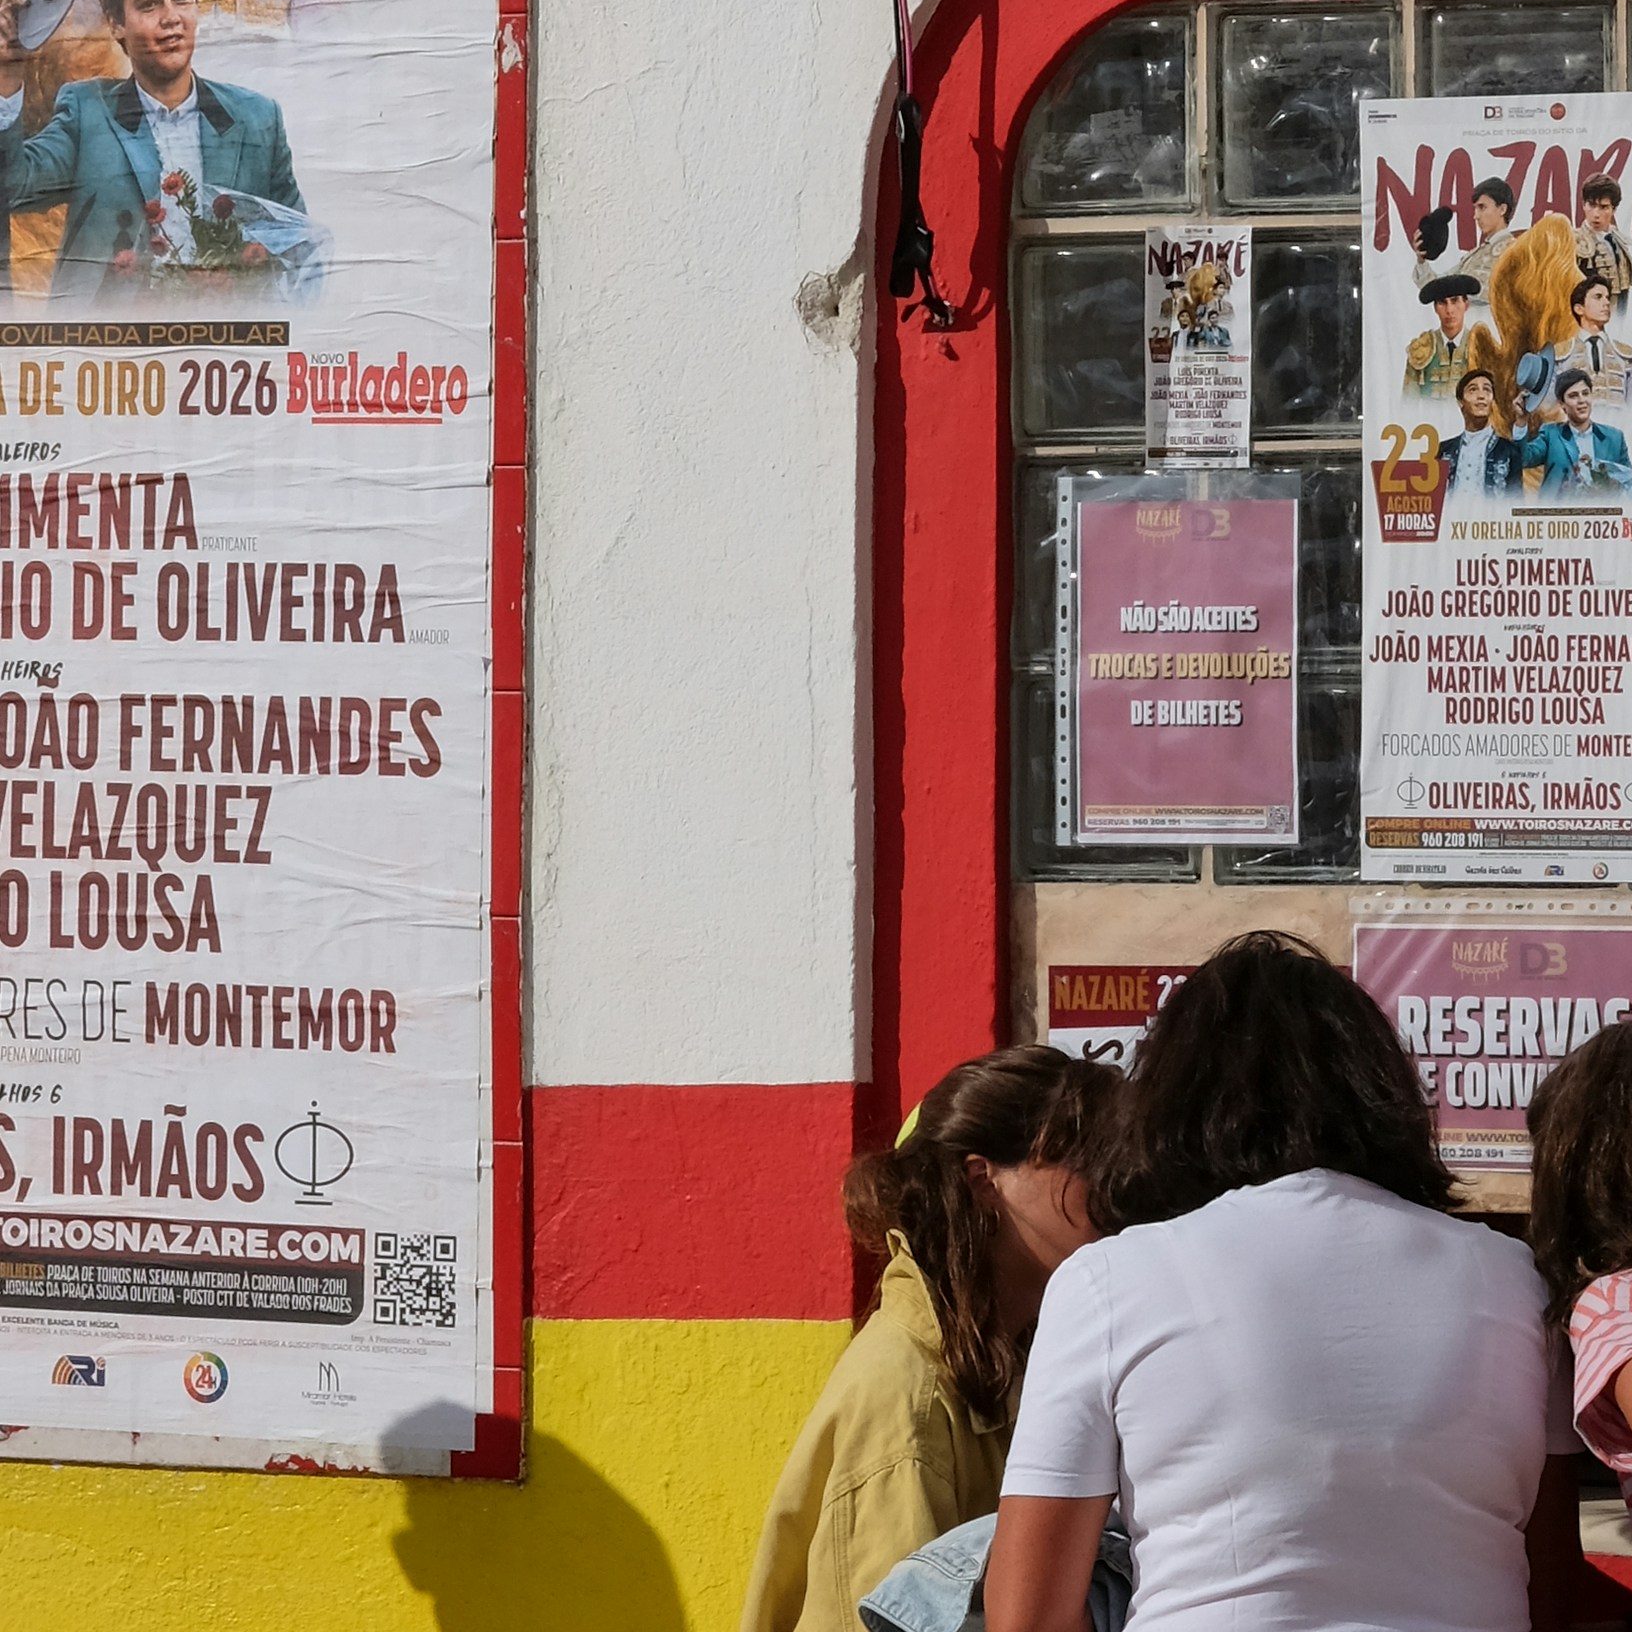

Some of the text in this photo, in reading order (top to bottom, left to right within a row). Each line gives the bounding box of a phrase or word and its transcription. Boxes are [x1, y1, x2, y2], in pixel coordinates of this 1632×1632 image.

[1147, 234, 1249, 277] NAZARÉ
[149, 324, 285, 345] POPULAR
[19, 359, 277, 417] DE OIRO 2026
[286, 351, 469, 418] Burladero
[1379, 423, 1440, 494] 23
[1384, 513, 1436, 531] 17 HORAS
[1387, 495, 1432, 513] AGOSTO
[202, 536, 258, 552] PRATICANTE
[1451, 520, 1619, 541] XV ORELHA DE OIRO 2026
[1456, 552, 1595, 588] LUÍS PIMENTA
[72, 561, 450, 646] DE OLIVEIRA AMADOR
[1120, 600, 1259, 633] NÃO SÃO ACEITES
[1381, 584, 1434, 618] JOÃO
[1440, 582, 1540, 618] GREGÓRIO
[1548, 588, 1573, 618] DE
[1369, 629, 1420, 663] JOÃO
[1427, 634, 1489, 663] MEXIA
[1505, 627, 1557, 664] JOÃO
[1088, 646, 1292, 684] TROCAS E DEVOLUÇÕES
[1427, 666, 1624, 698] MARTIM VELAZQUEZ
[1131, 699, 1243, 727] DE BILHETES
[1445, 697, 1605, 725] RODRIGO LOUSA
[119, 693, 442, 779] FERNANDES
[1382, 732, 1462, 757] FORCADOS
[1465, 733, 1549, 758] AMADORES
[1554, 734, 1572, 758] DE
[1428, 777, 1622, 813] OLIVEIRAS, IRMÃOS
[50, 870, 222, 953] LOUSA
[1054, 968, 1150, 1011] NAZARÉ
[82, 979, 397, 1054] DE MONTEMOR
[29, 1047, 81, 1064] MONTEIRO
[52, 1104, 266, 1204] IRMÃOS
[47, 1263, 80, 1284] PRAÇA
[82, 1265, 95, 1282] DE
[97, 1266, 132, 1285] TOIROS
[133, 1268, 147, 1285] NA
[149, 1269, 190, 1287] SEMANA
[191, 1271, 241, 1289] ANTERIOR
[251, 1275, 296, 1293] CORRIDA
